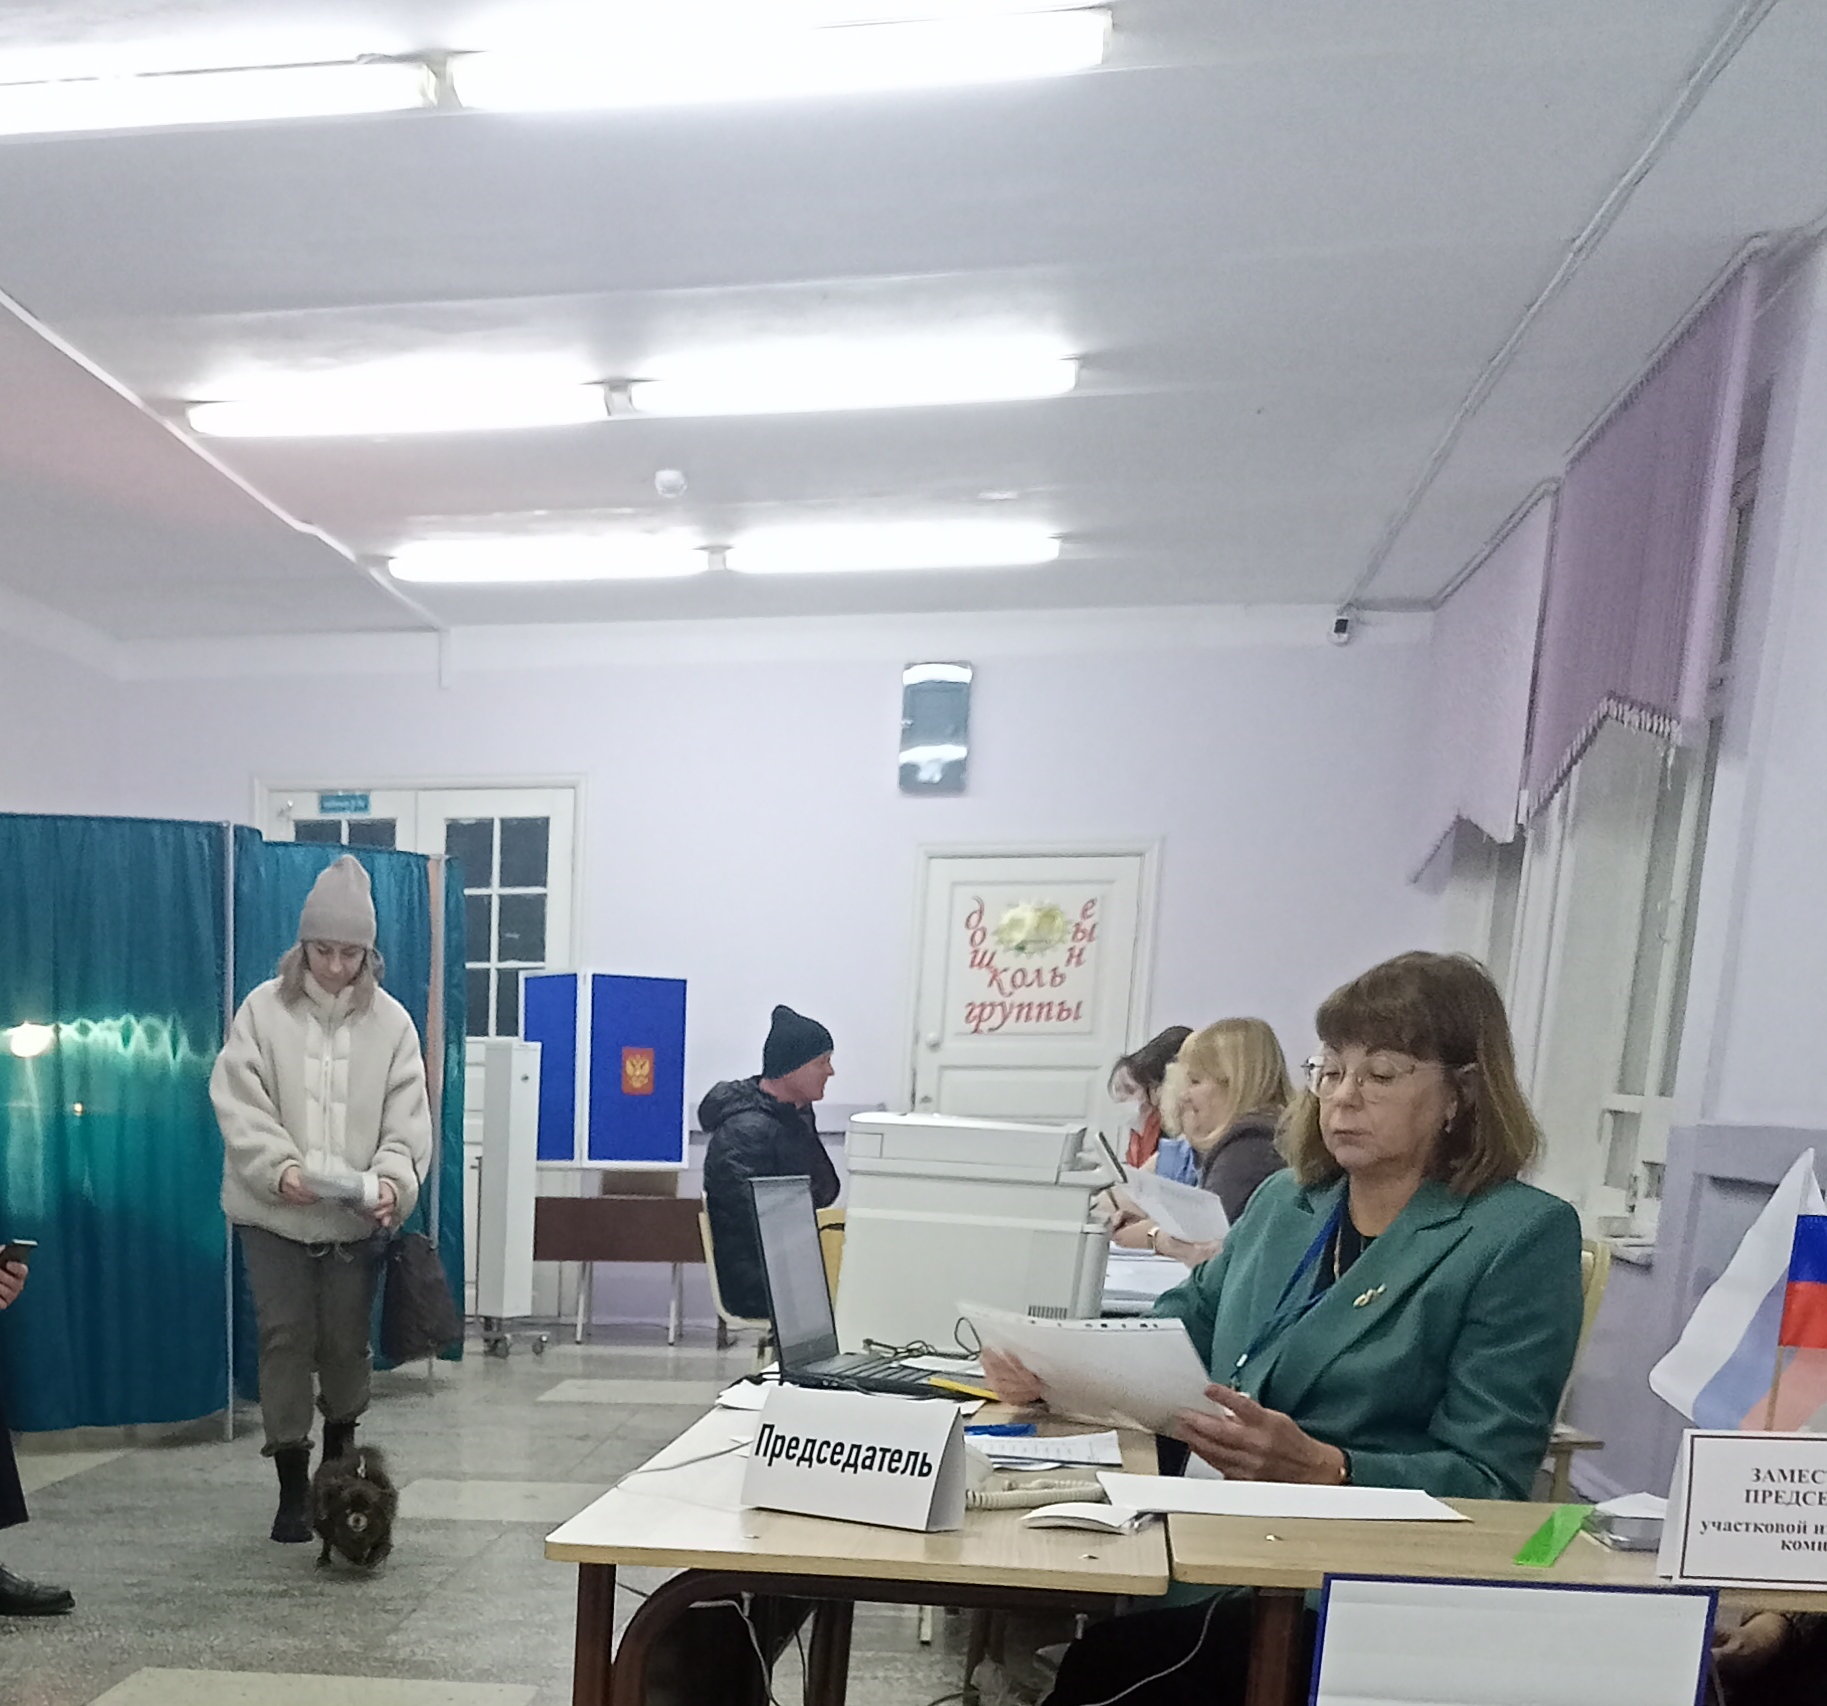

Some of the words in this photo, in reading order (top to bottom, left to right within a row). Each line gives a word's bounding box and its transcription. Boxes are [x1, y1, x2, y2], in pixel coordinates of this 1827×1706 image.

[965, 1000, 1083, 1034] группы
[755, 1423, 933, 1478] Председатель
[1751, 1467, 1827, 1485] ЗАМЕС
[1700, 1519, 1808, 1535] участковой
